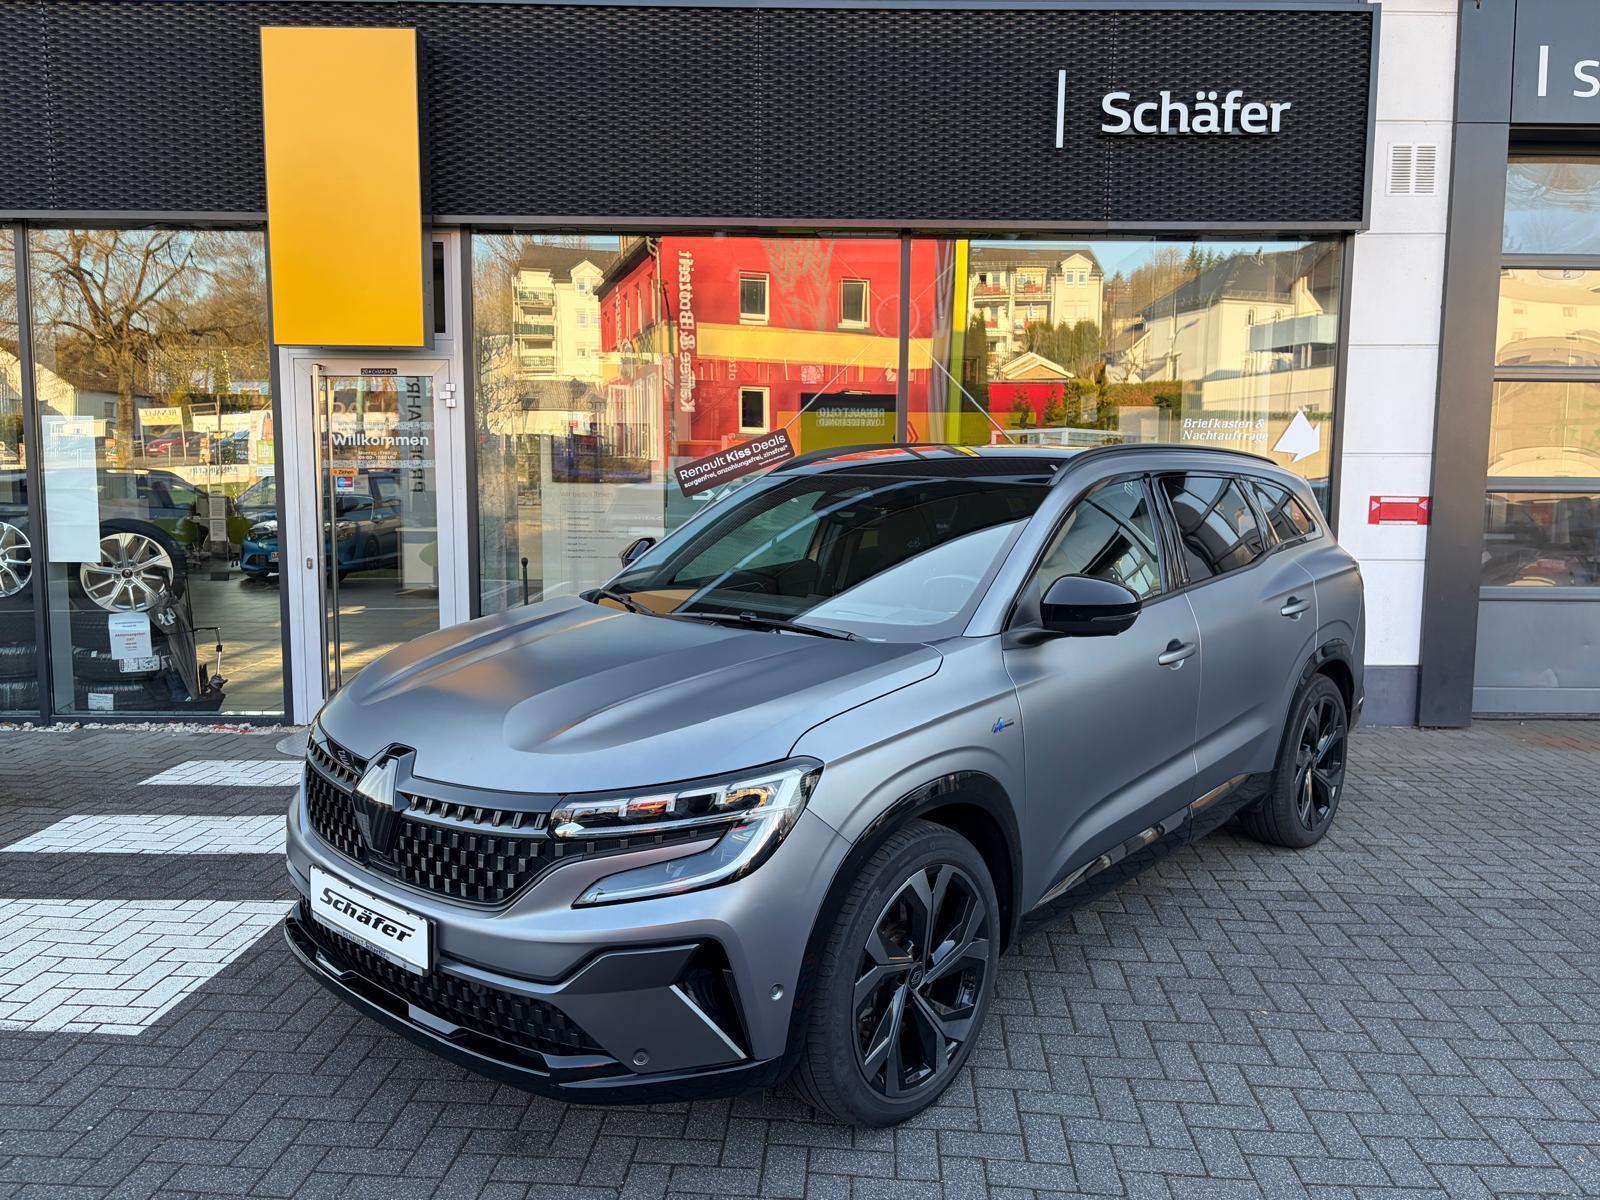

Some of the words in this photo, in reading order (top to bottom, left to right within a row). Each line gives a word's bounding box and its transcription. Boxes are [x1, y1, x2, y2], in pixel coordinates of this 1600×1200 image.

[1101, 90, 1292, 134] Schäfer
[332, 433, 429, 446] Willkommen
[1183, 418, 1254, 429] Briefkasten
[1255, 418, 1265, 429] &
[680, 457, 726, 480] Renault
[726, 447, 752, 463] Kiss
[752, 434, 786, 453] Deals
[684, 472, 718, 488] sorgenfrei,
[717, 453, 763, 475] anzahlungsfrei,
[320, 887, 414, 942] Schäfer
